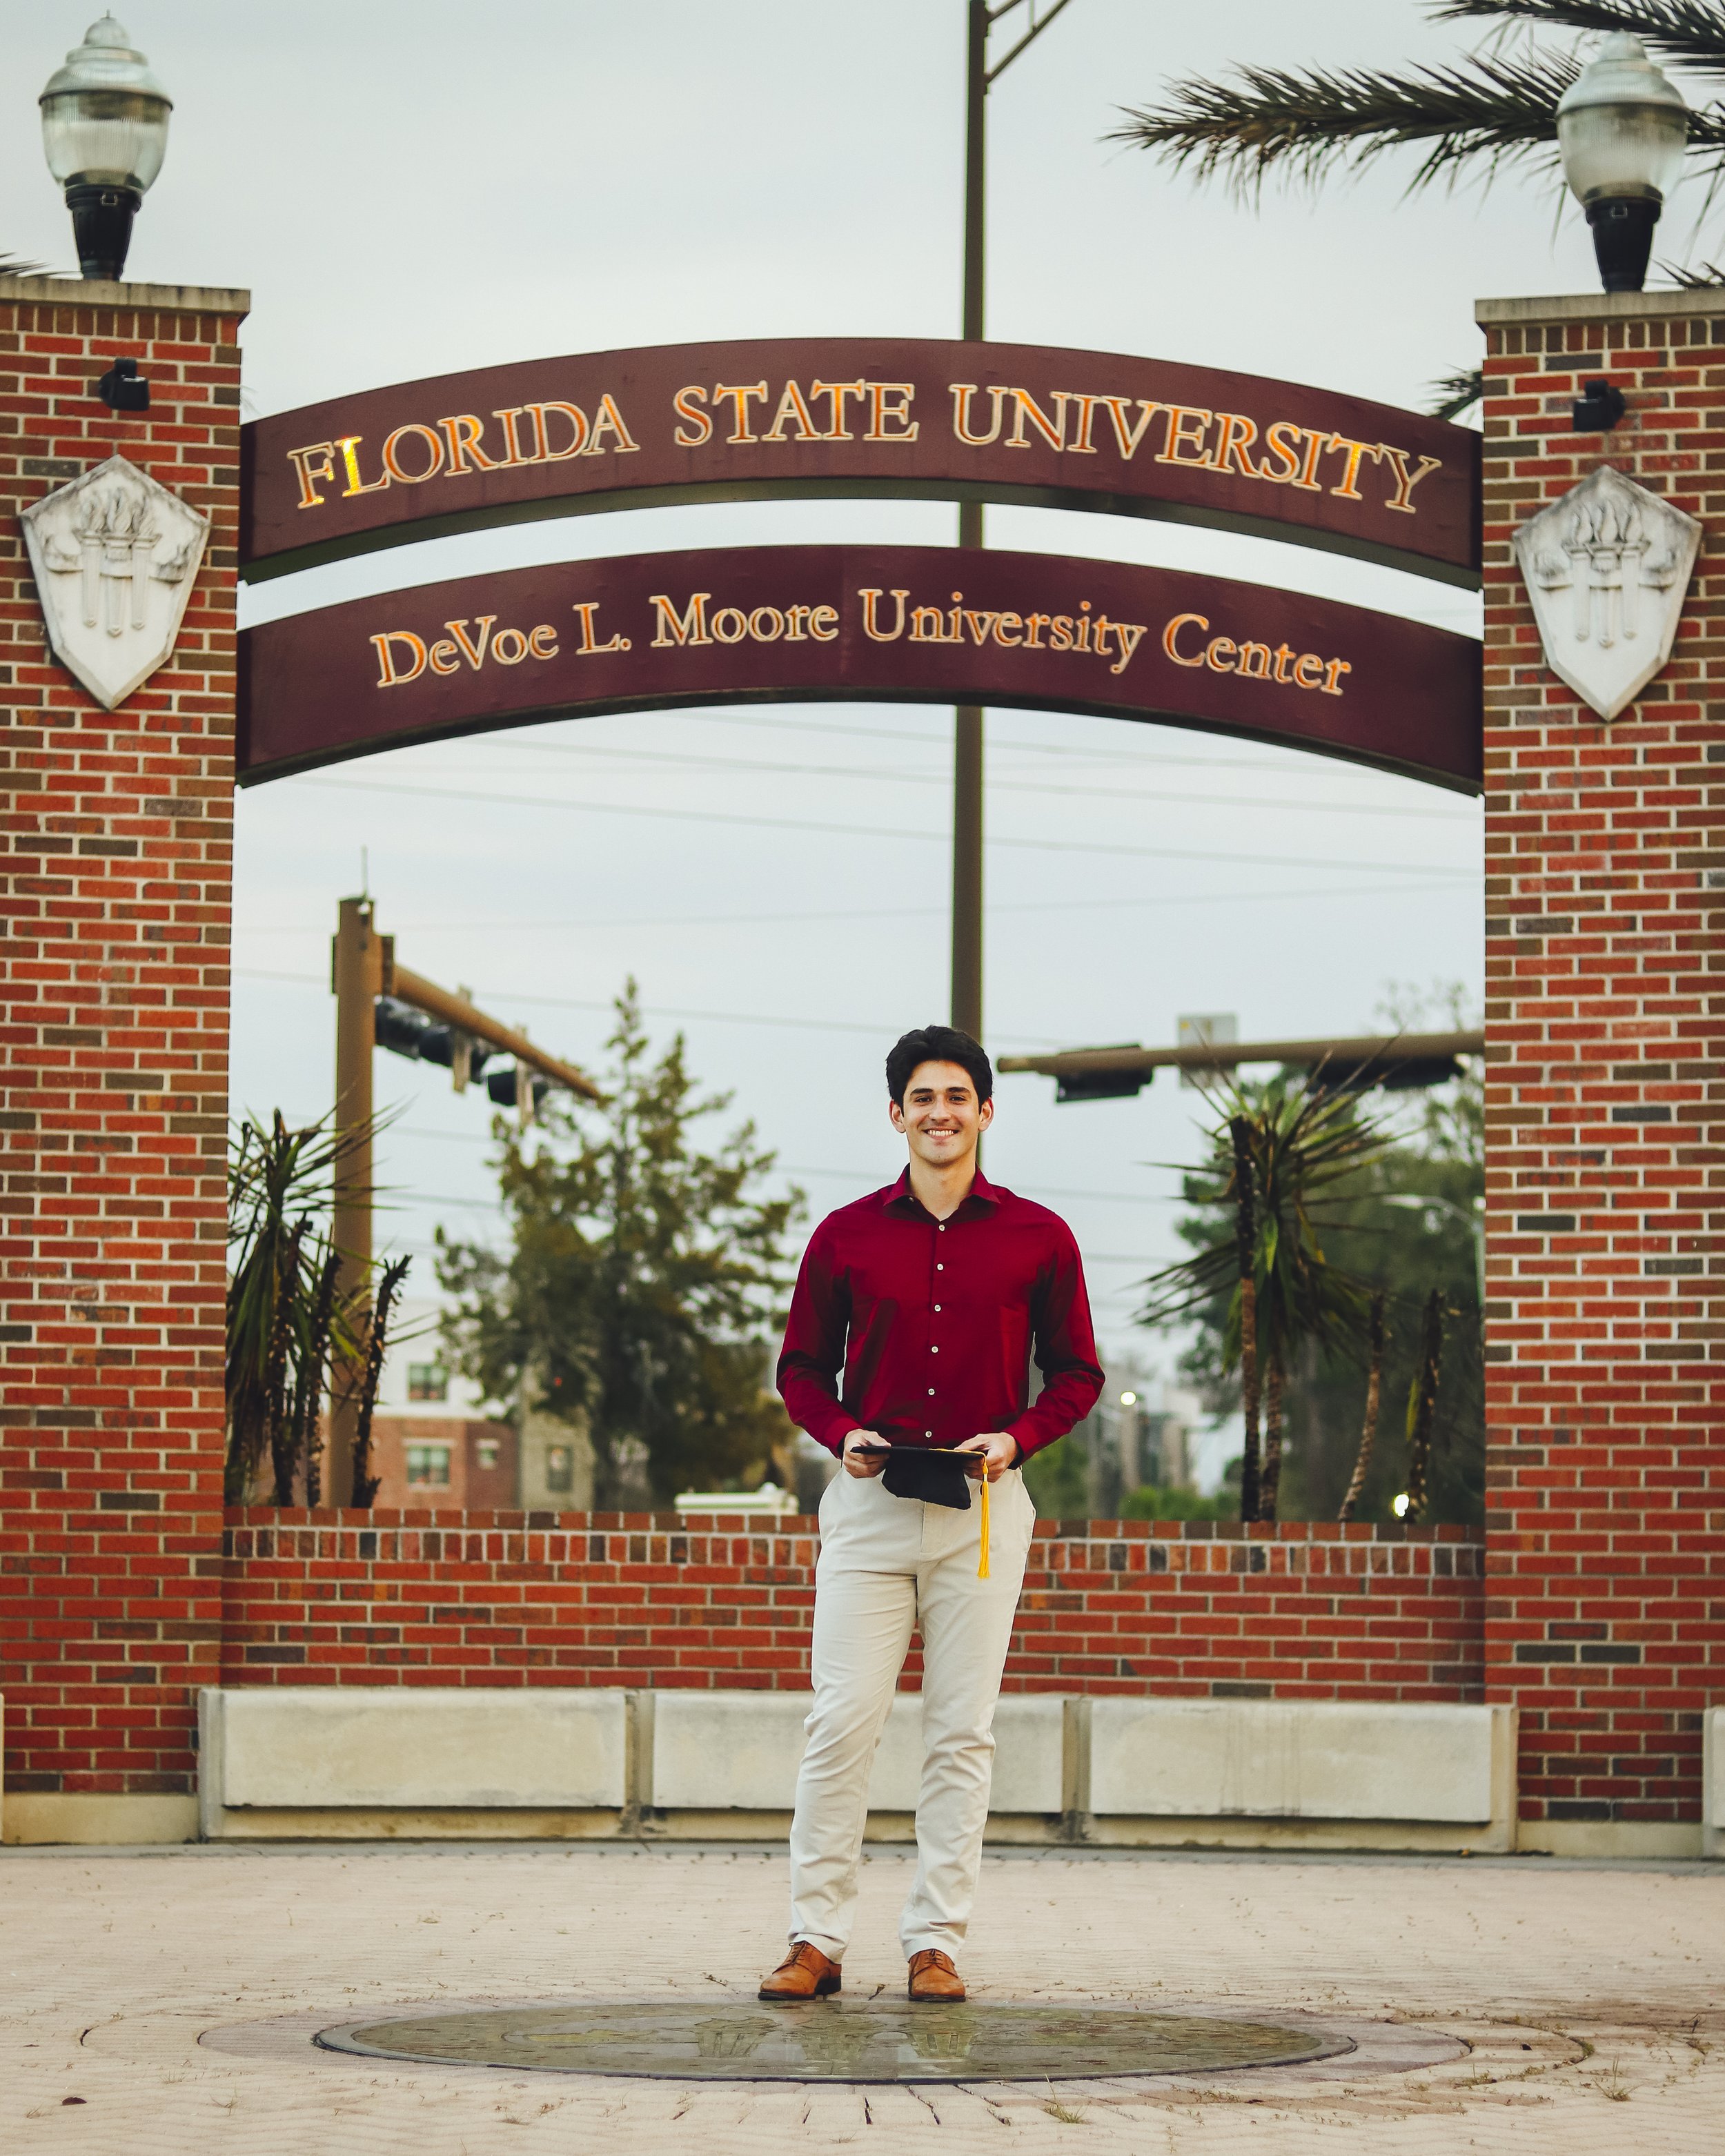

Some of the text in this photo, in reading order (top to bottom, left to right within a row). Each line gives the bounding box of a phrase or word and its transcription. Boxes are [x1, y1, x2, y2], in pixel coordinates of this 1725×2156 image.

[286, 377, 1442, 514] FLORIDA STATE UNIVERSITY
[368, 589, 1352, 696] DeVoe L. Moore University Center
